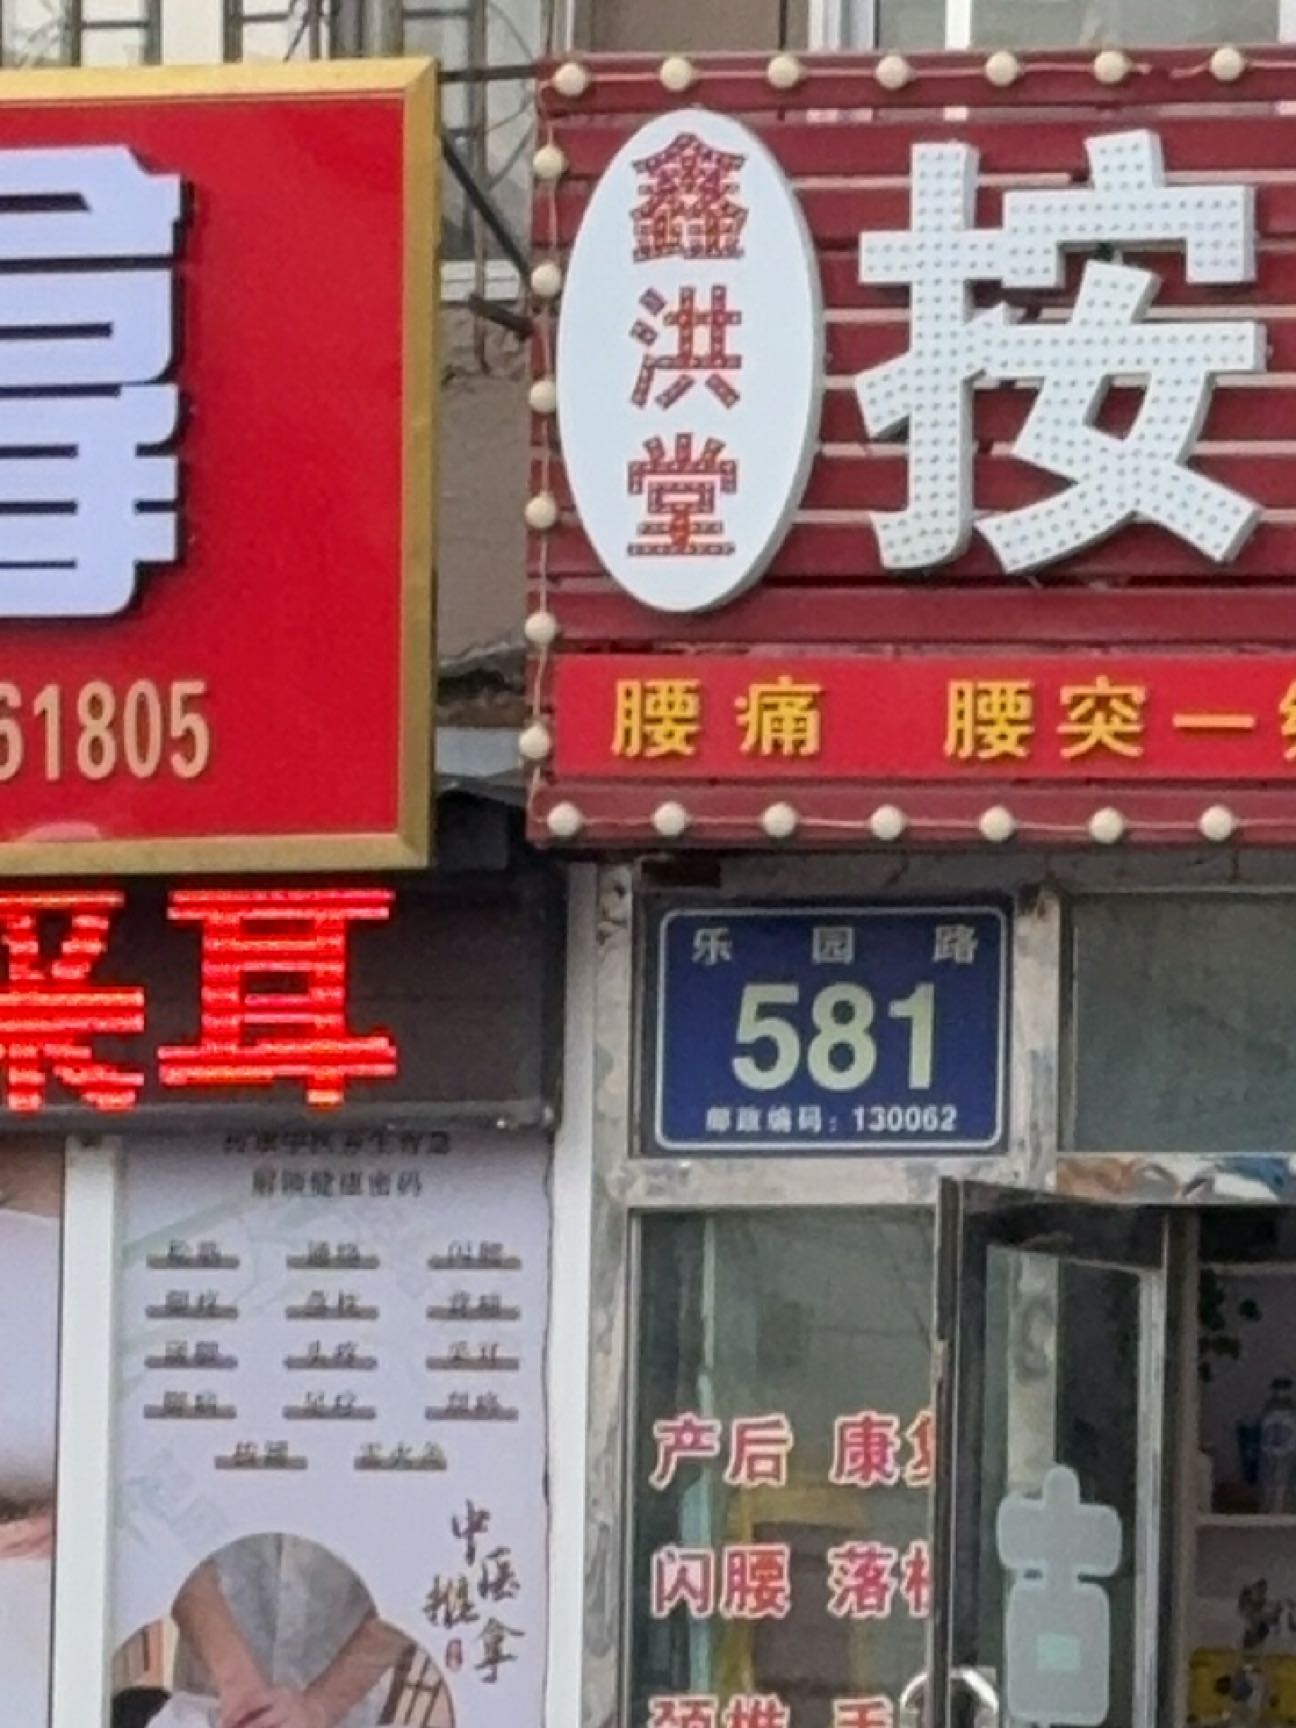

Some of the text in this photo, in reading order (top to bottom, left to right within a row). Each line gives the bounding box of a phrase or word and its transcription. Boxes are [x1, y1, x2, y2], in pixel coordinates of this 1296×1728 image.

[627, 131, 749, 558] 鑫洪堂
[612, 676, 823, 758] 腰痛
[692, 924, 979, 966] 乐园路
[732, 981, 936, 1091] 581
[650, 1411, 792, 1488] 产后
[651, 1543, 790, 1618] 闪腰
